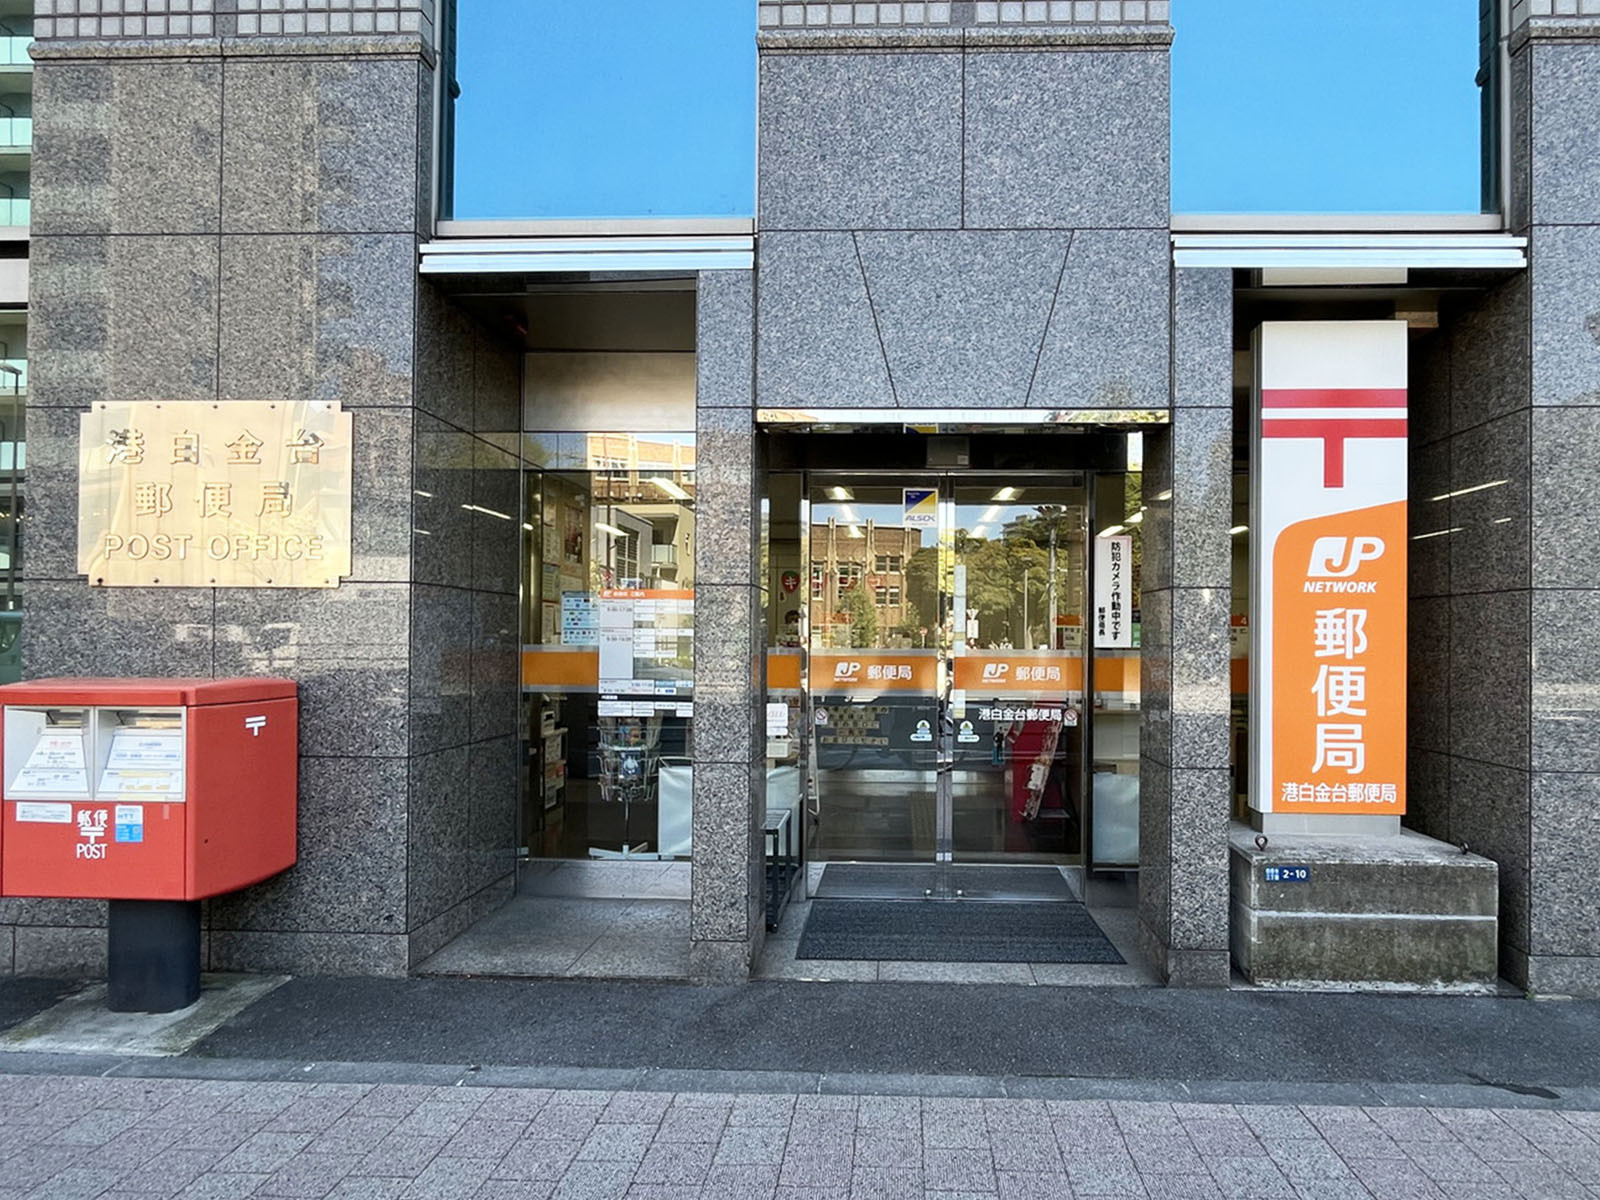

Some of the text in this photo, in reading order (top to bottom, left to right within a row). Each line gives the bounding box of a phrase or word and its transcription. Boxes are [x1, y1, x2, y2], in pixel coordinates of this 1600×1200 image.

[105, 428, 325, 465] 港白金台
[134, 481, 293, 518] 郵便局
[103, 534, 324, 561] POST OFFICE
[1307, 536, 1385, 577] JP
[1111, 541, 1121, 640] 防犯カメラ作動中です
[1303, 581, 1377, 593] NETWORK
[834, 662, 912, 680] JP 郵便局
[983, 663, 1061, 681] JP 郵便局
[1311, 607, 1368, 775] 郵便局
[978, 708, 1063, 722] 港白金台郵便局
[1281, 782, 1397, 804] 港白金台郵便局
[77, 810, 108, 828] 郵便
[76, 843, 108, 860] POST
[1283, 869, 1307, 879] 2-10
